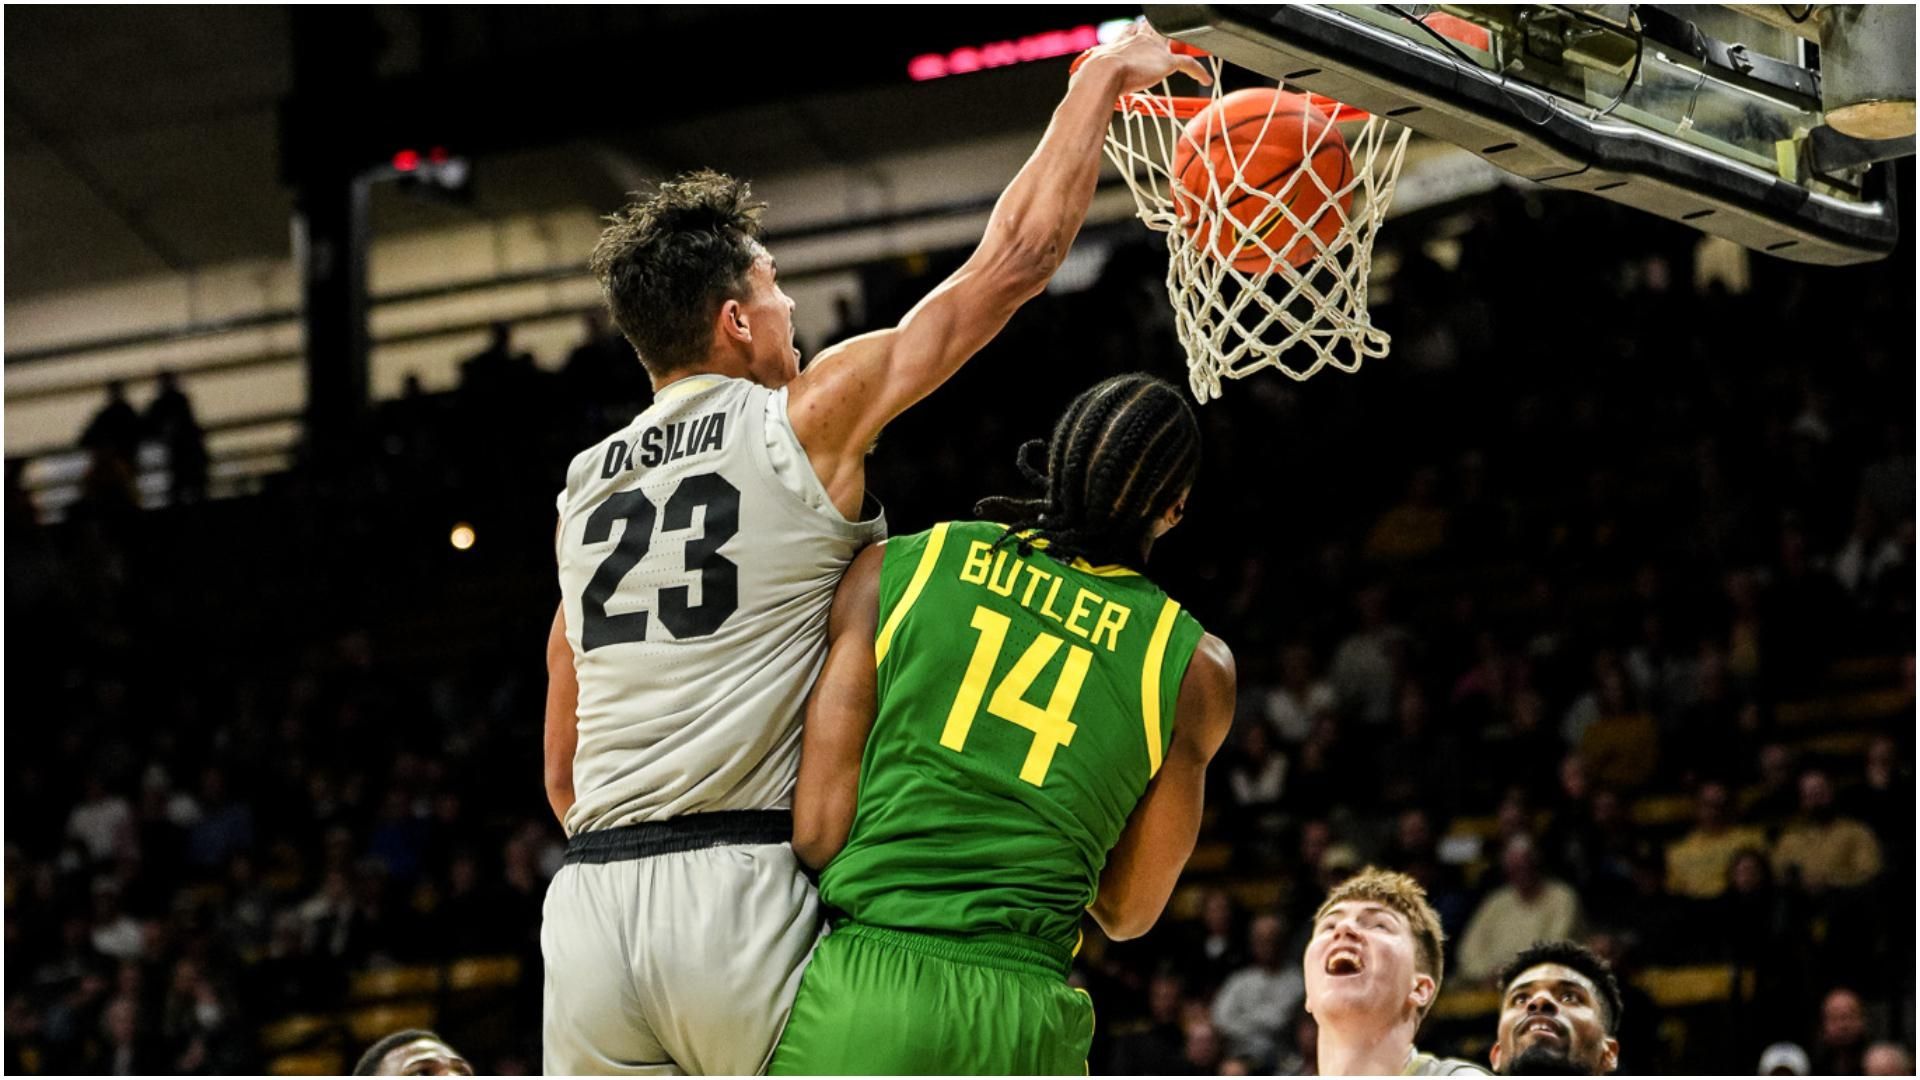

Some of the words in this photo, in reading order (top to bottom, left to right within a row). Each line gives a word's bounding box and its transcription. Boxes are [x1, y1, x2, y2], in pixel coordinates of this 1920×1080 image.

[641, 412, 726, 468] SILVA
[581, 472, 741, 653] 23
[960, 540, 1131, 652] BUTLER
[939, 605, 1094, 788] 14
